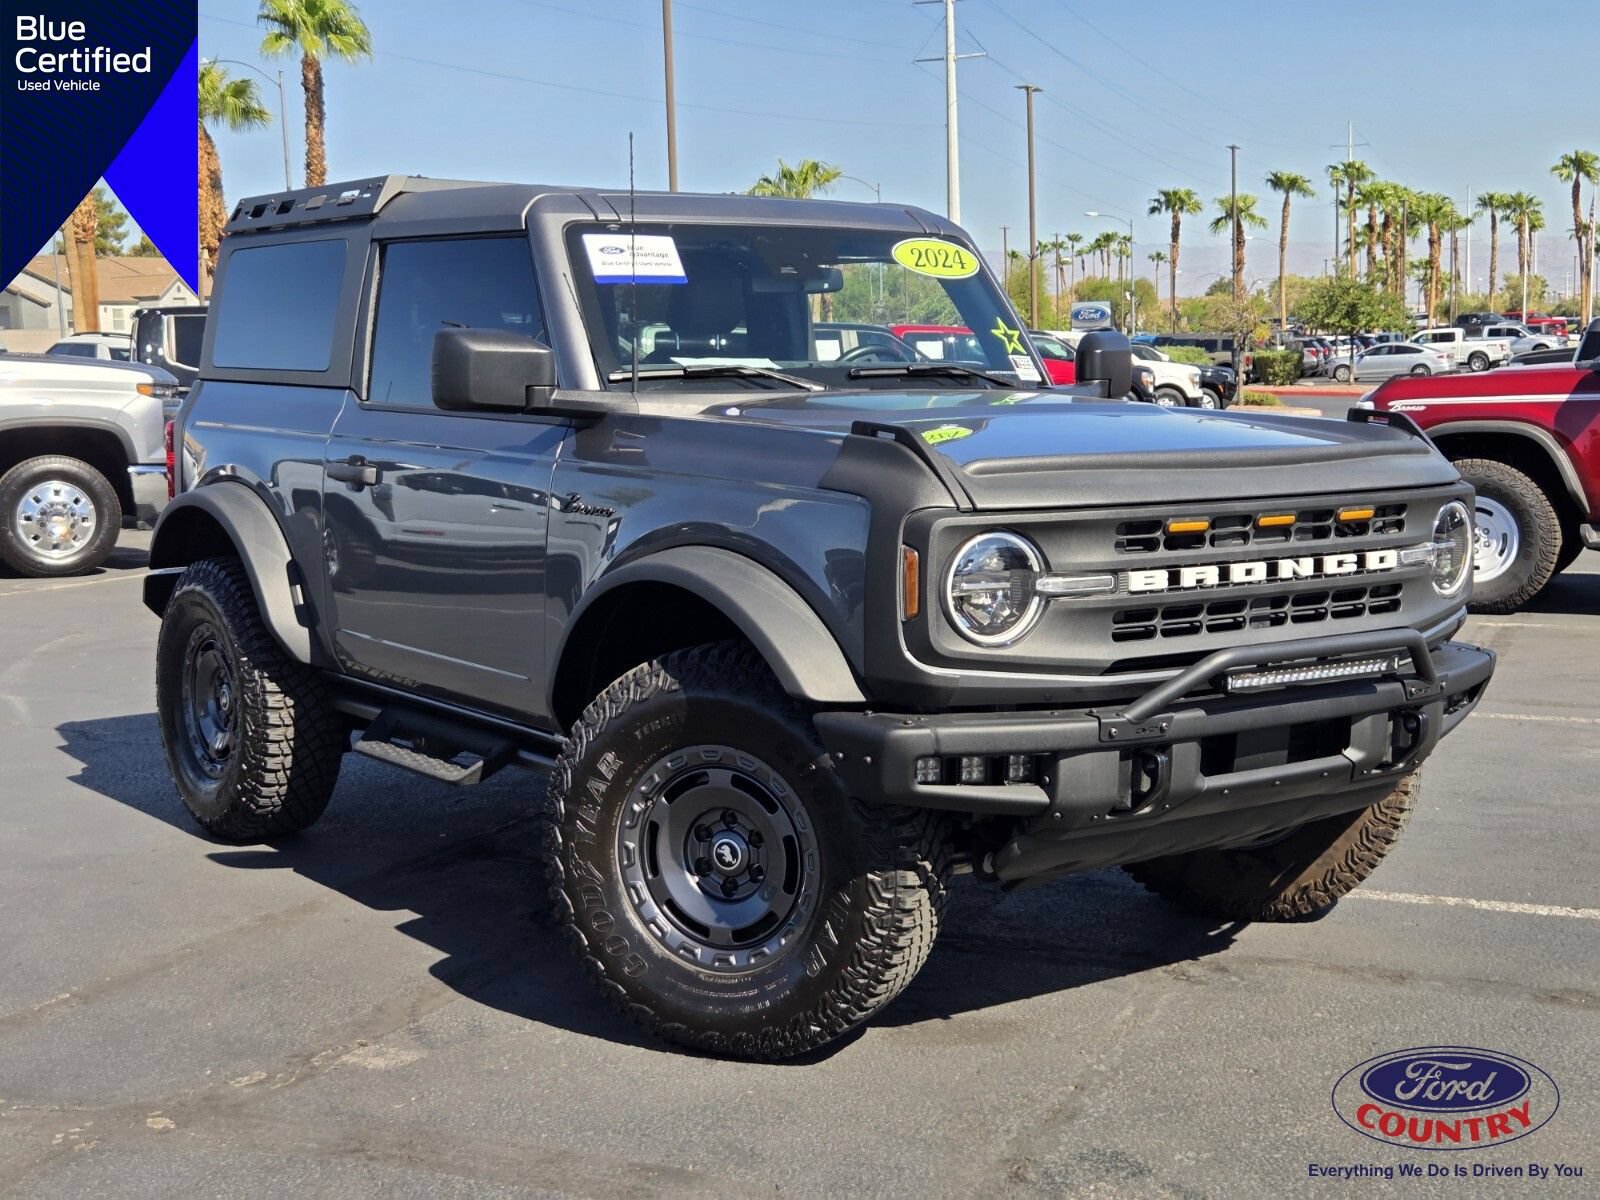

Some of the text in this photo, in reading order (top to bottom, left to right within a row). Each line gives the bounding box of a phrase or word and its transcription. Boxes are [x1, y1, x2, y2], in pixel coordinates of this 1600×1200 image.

[910, 247, 967, 270] 2024
[1078, 309, 1101, 320] Ford
[1388, 401, 1427, 411] Bronco
[1128, 549, 1398, 592] BRONCO
[569, 751, 649, 978] GOODYEAR
